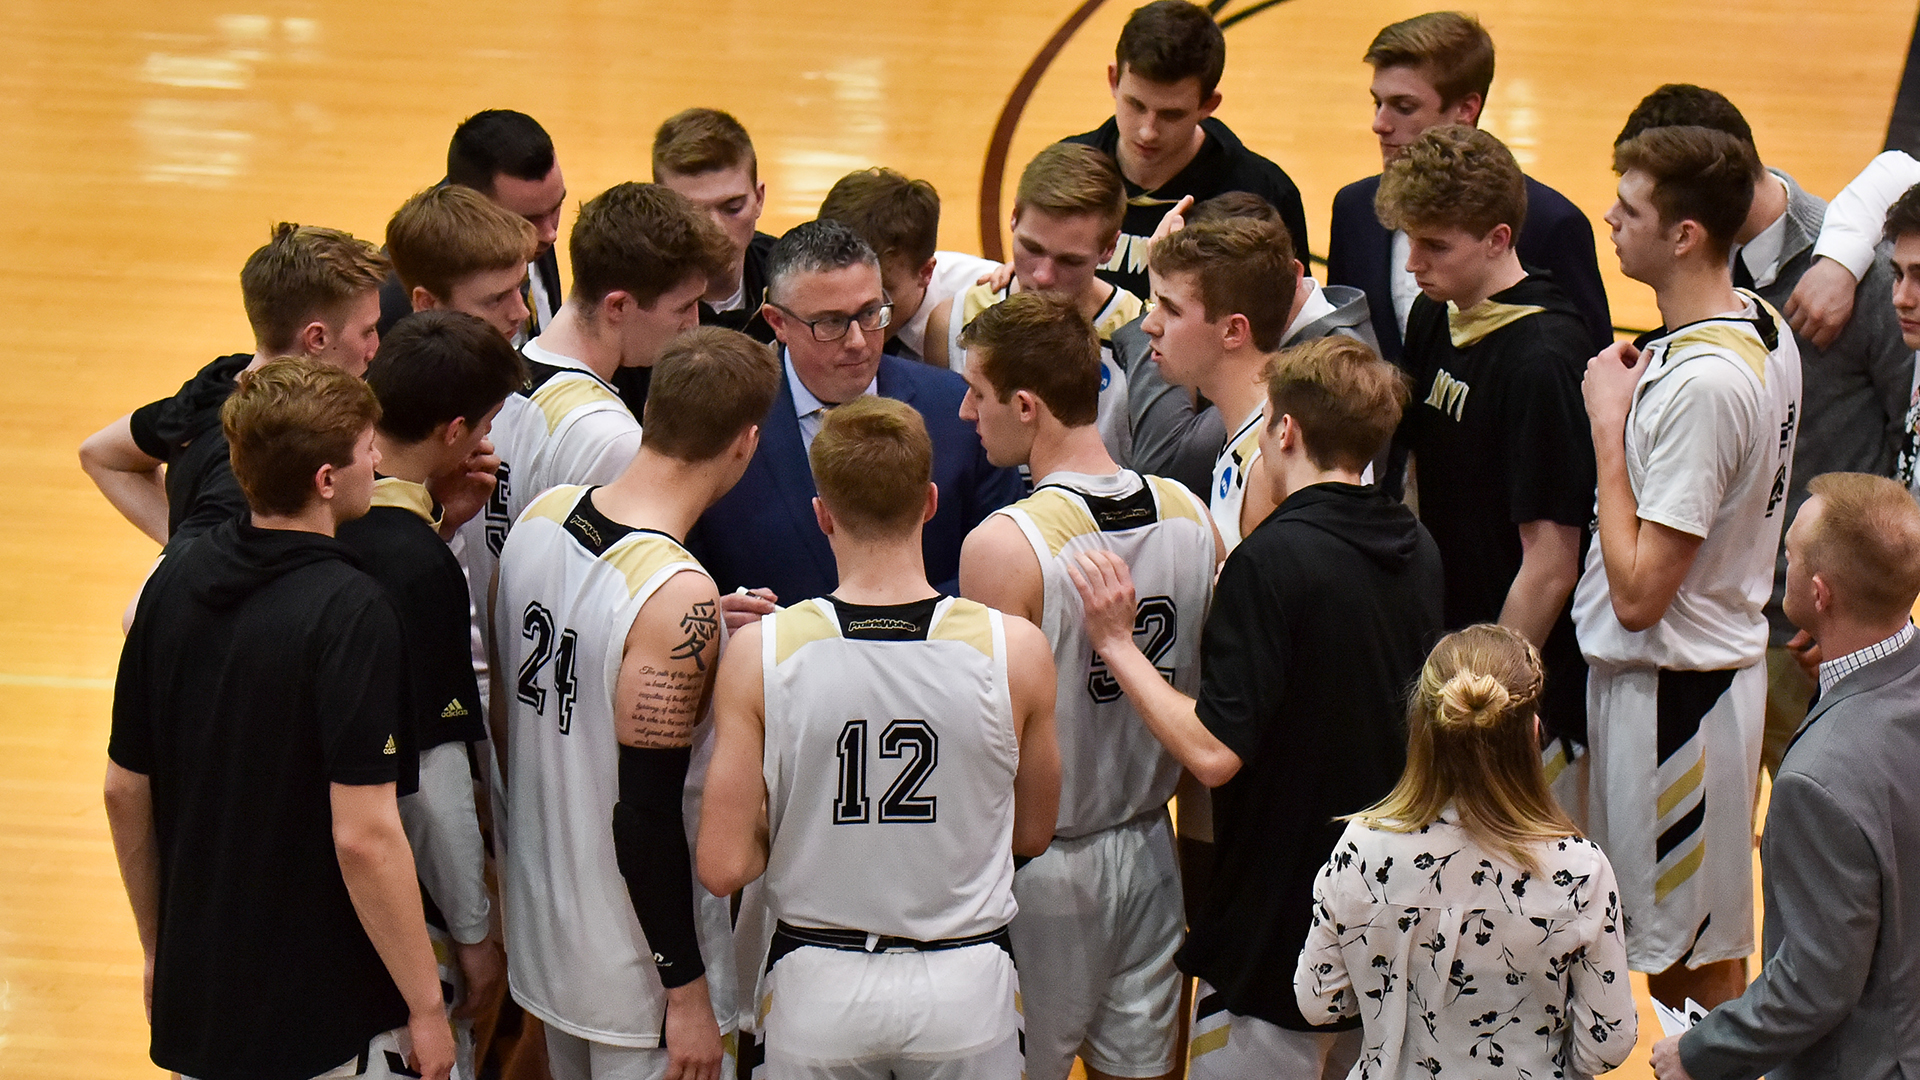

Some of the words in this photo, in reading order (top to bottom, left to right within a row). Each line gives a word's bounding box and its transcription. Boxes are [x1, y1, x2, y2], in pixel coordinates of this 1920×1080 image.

[517, 600, 578, 735] 24
[670, 599, 718, 671] 愛
[440, 708, 469, 718] adidas
[833, 719, 938, 825] 12
